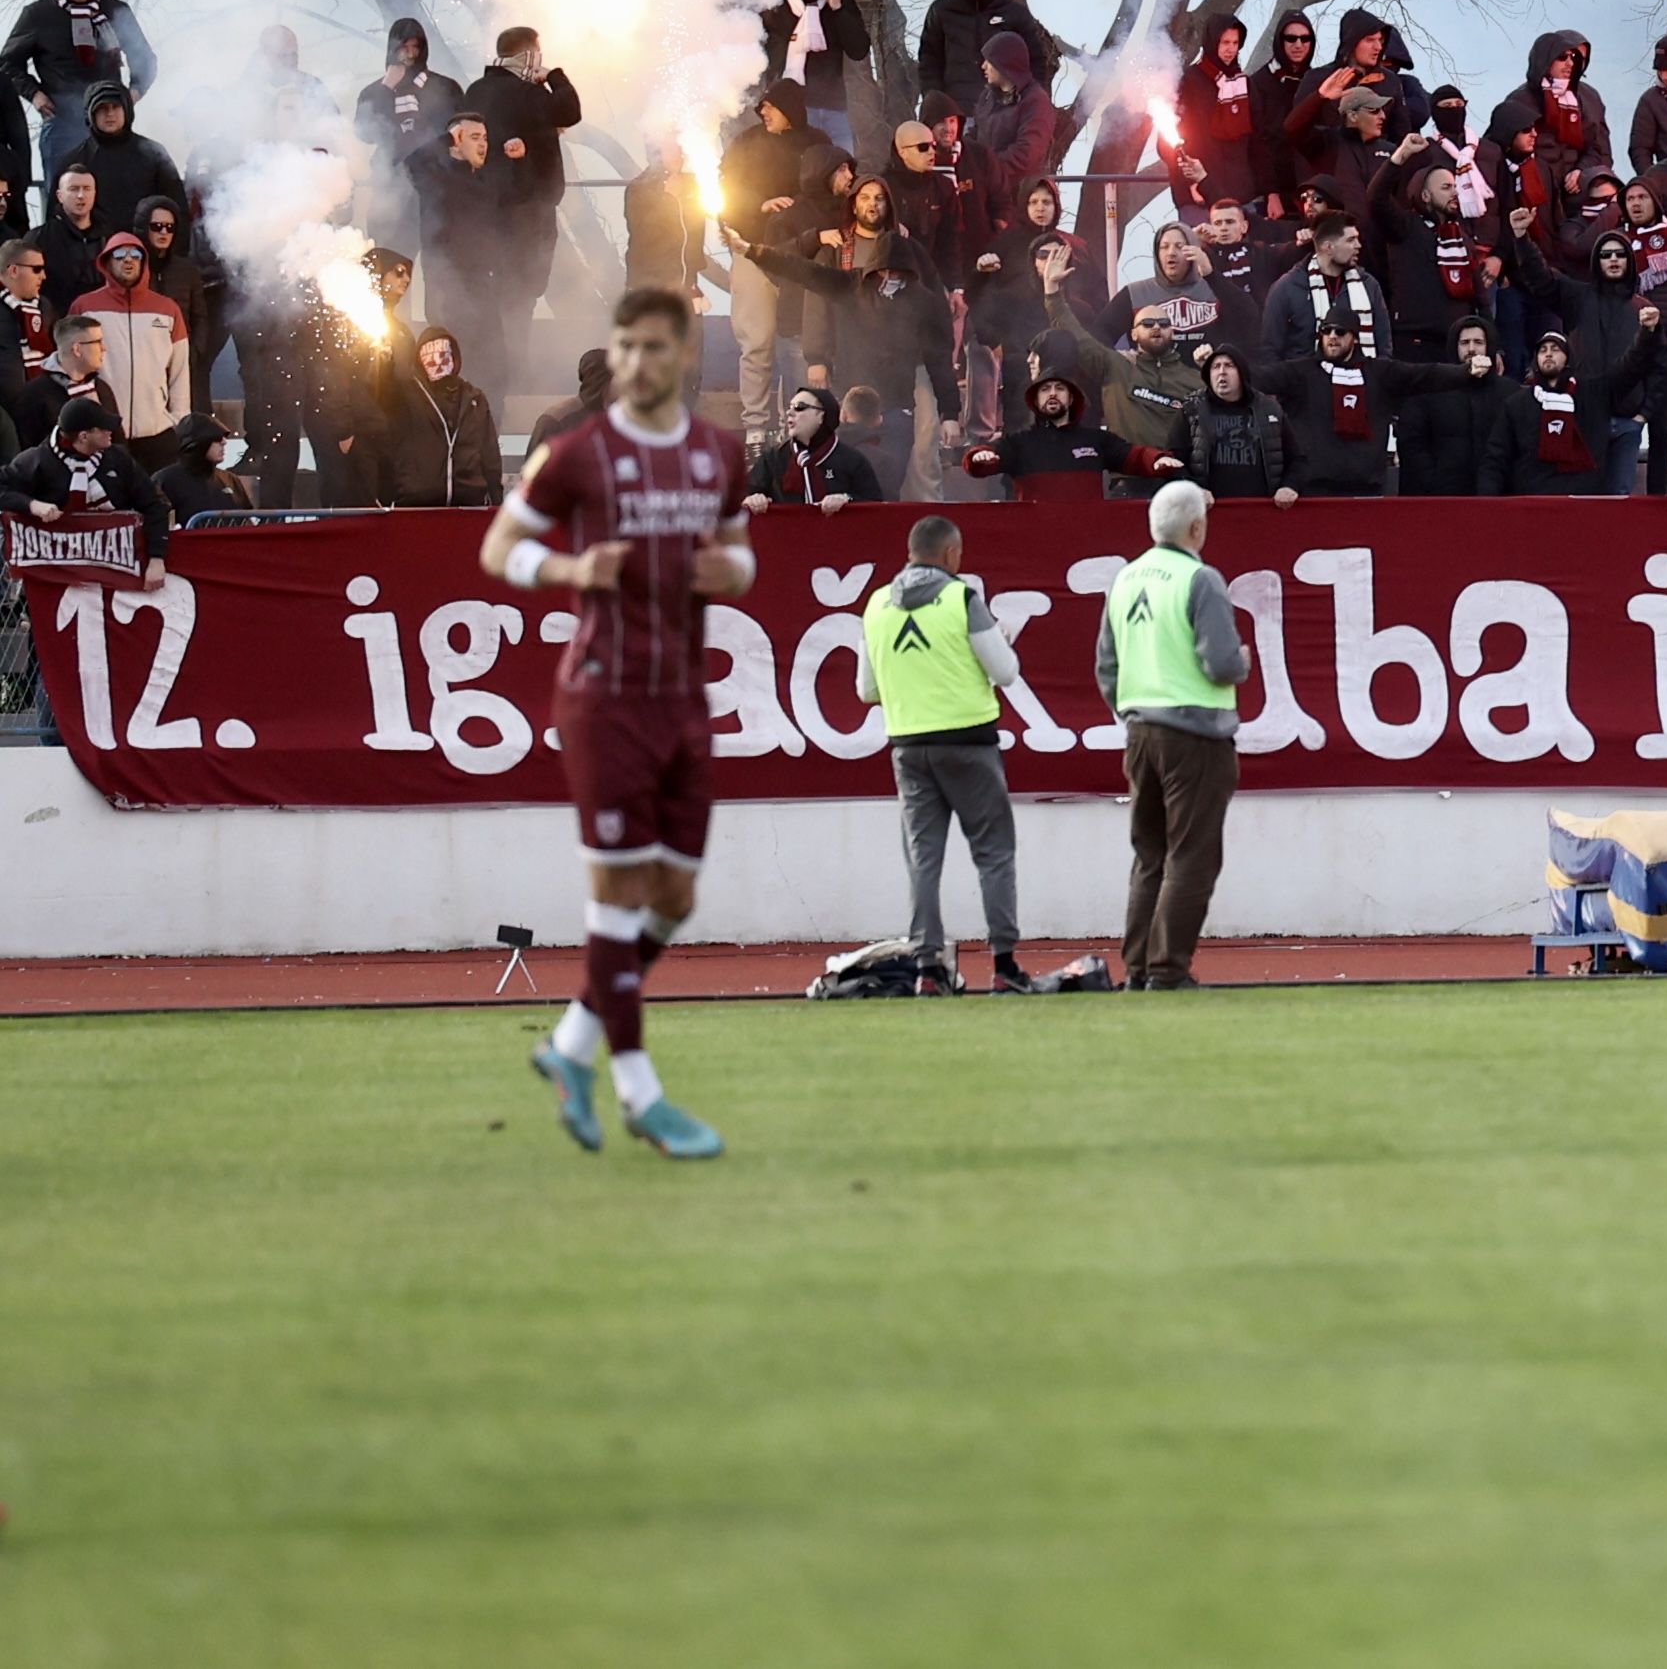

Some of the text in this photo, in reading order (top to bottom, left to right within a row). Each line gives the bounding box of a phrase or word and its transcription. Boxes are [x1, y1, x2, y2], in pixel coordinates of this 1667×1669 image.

[1133, 386, 1171, 406] ellesse
[10, 521, 136, 566] NORTHMAN
[57, 574, 256, 750] 12.
[344, 563, 889, 774] igač
